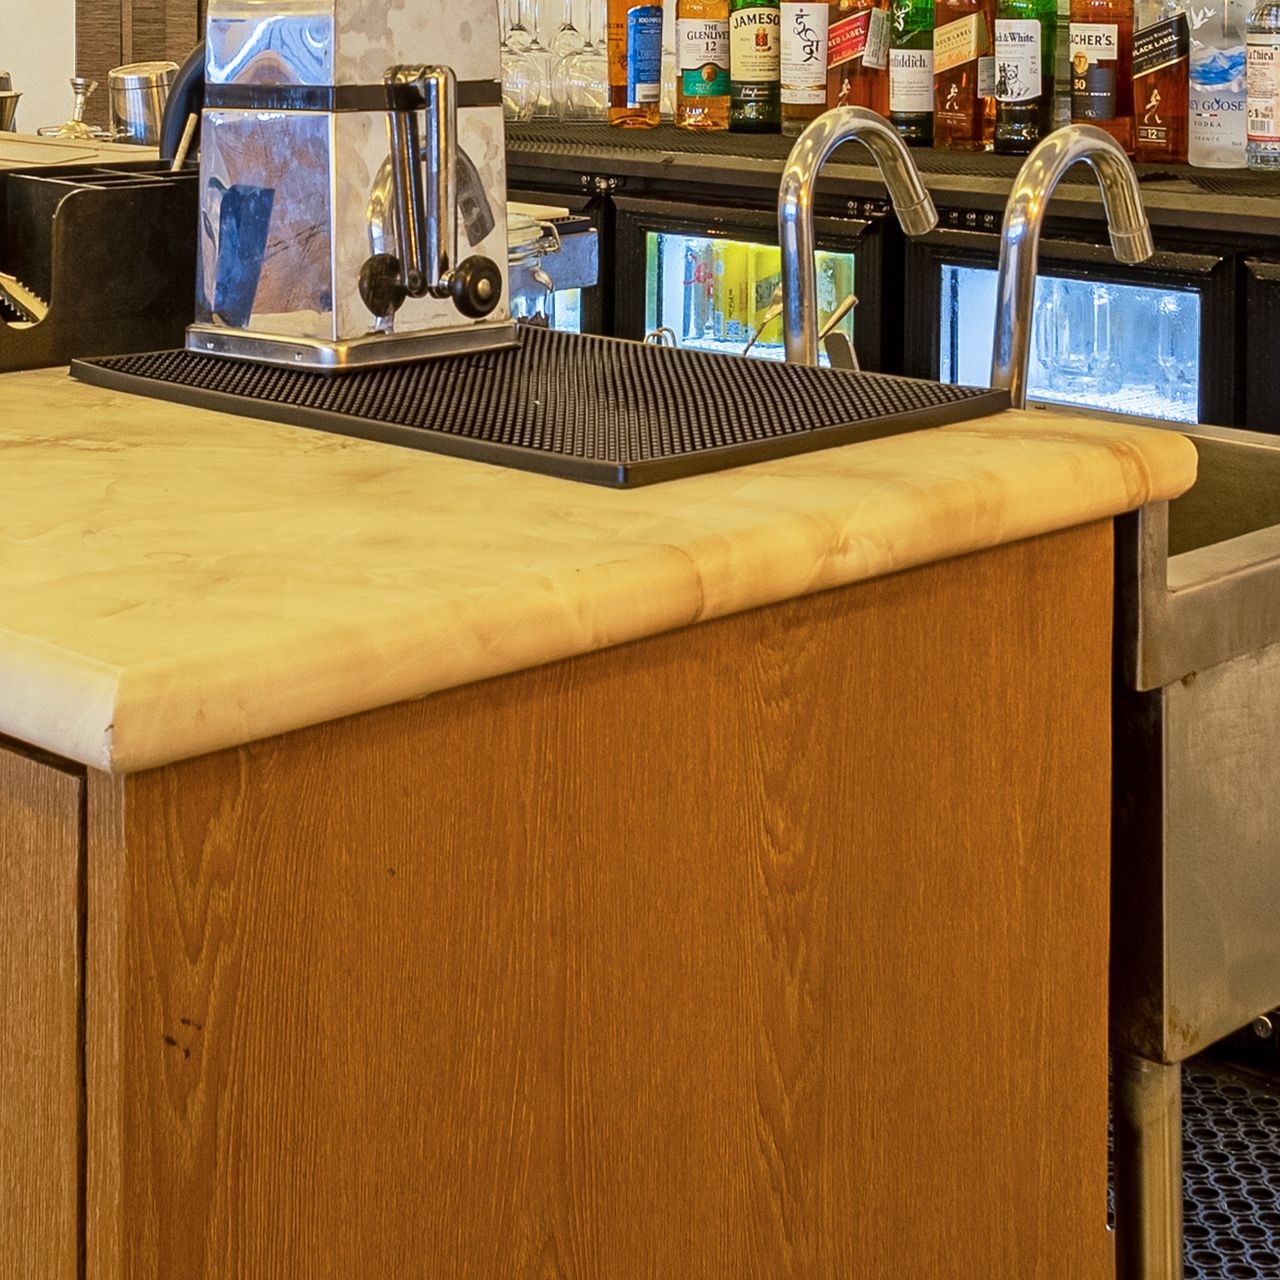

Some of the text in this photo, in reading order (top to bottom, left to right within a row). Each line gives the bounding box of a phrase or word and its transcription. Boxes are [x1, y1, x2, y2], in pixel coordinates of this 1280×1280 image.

[841, 27, 866, 42] LABEL
[1009, 32, 1034, 43] White
[704, 40, 717, 51] 12
[1153, 34, 1179, 48] LABEL
[1074, 79, 1086, 90] 50
[1202, 98, 1244, 112] GOOSE
[1147, 129, 1158, 139] 12
